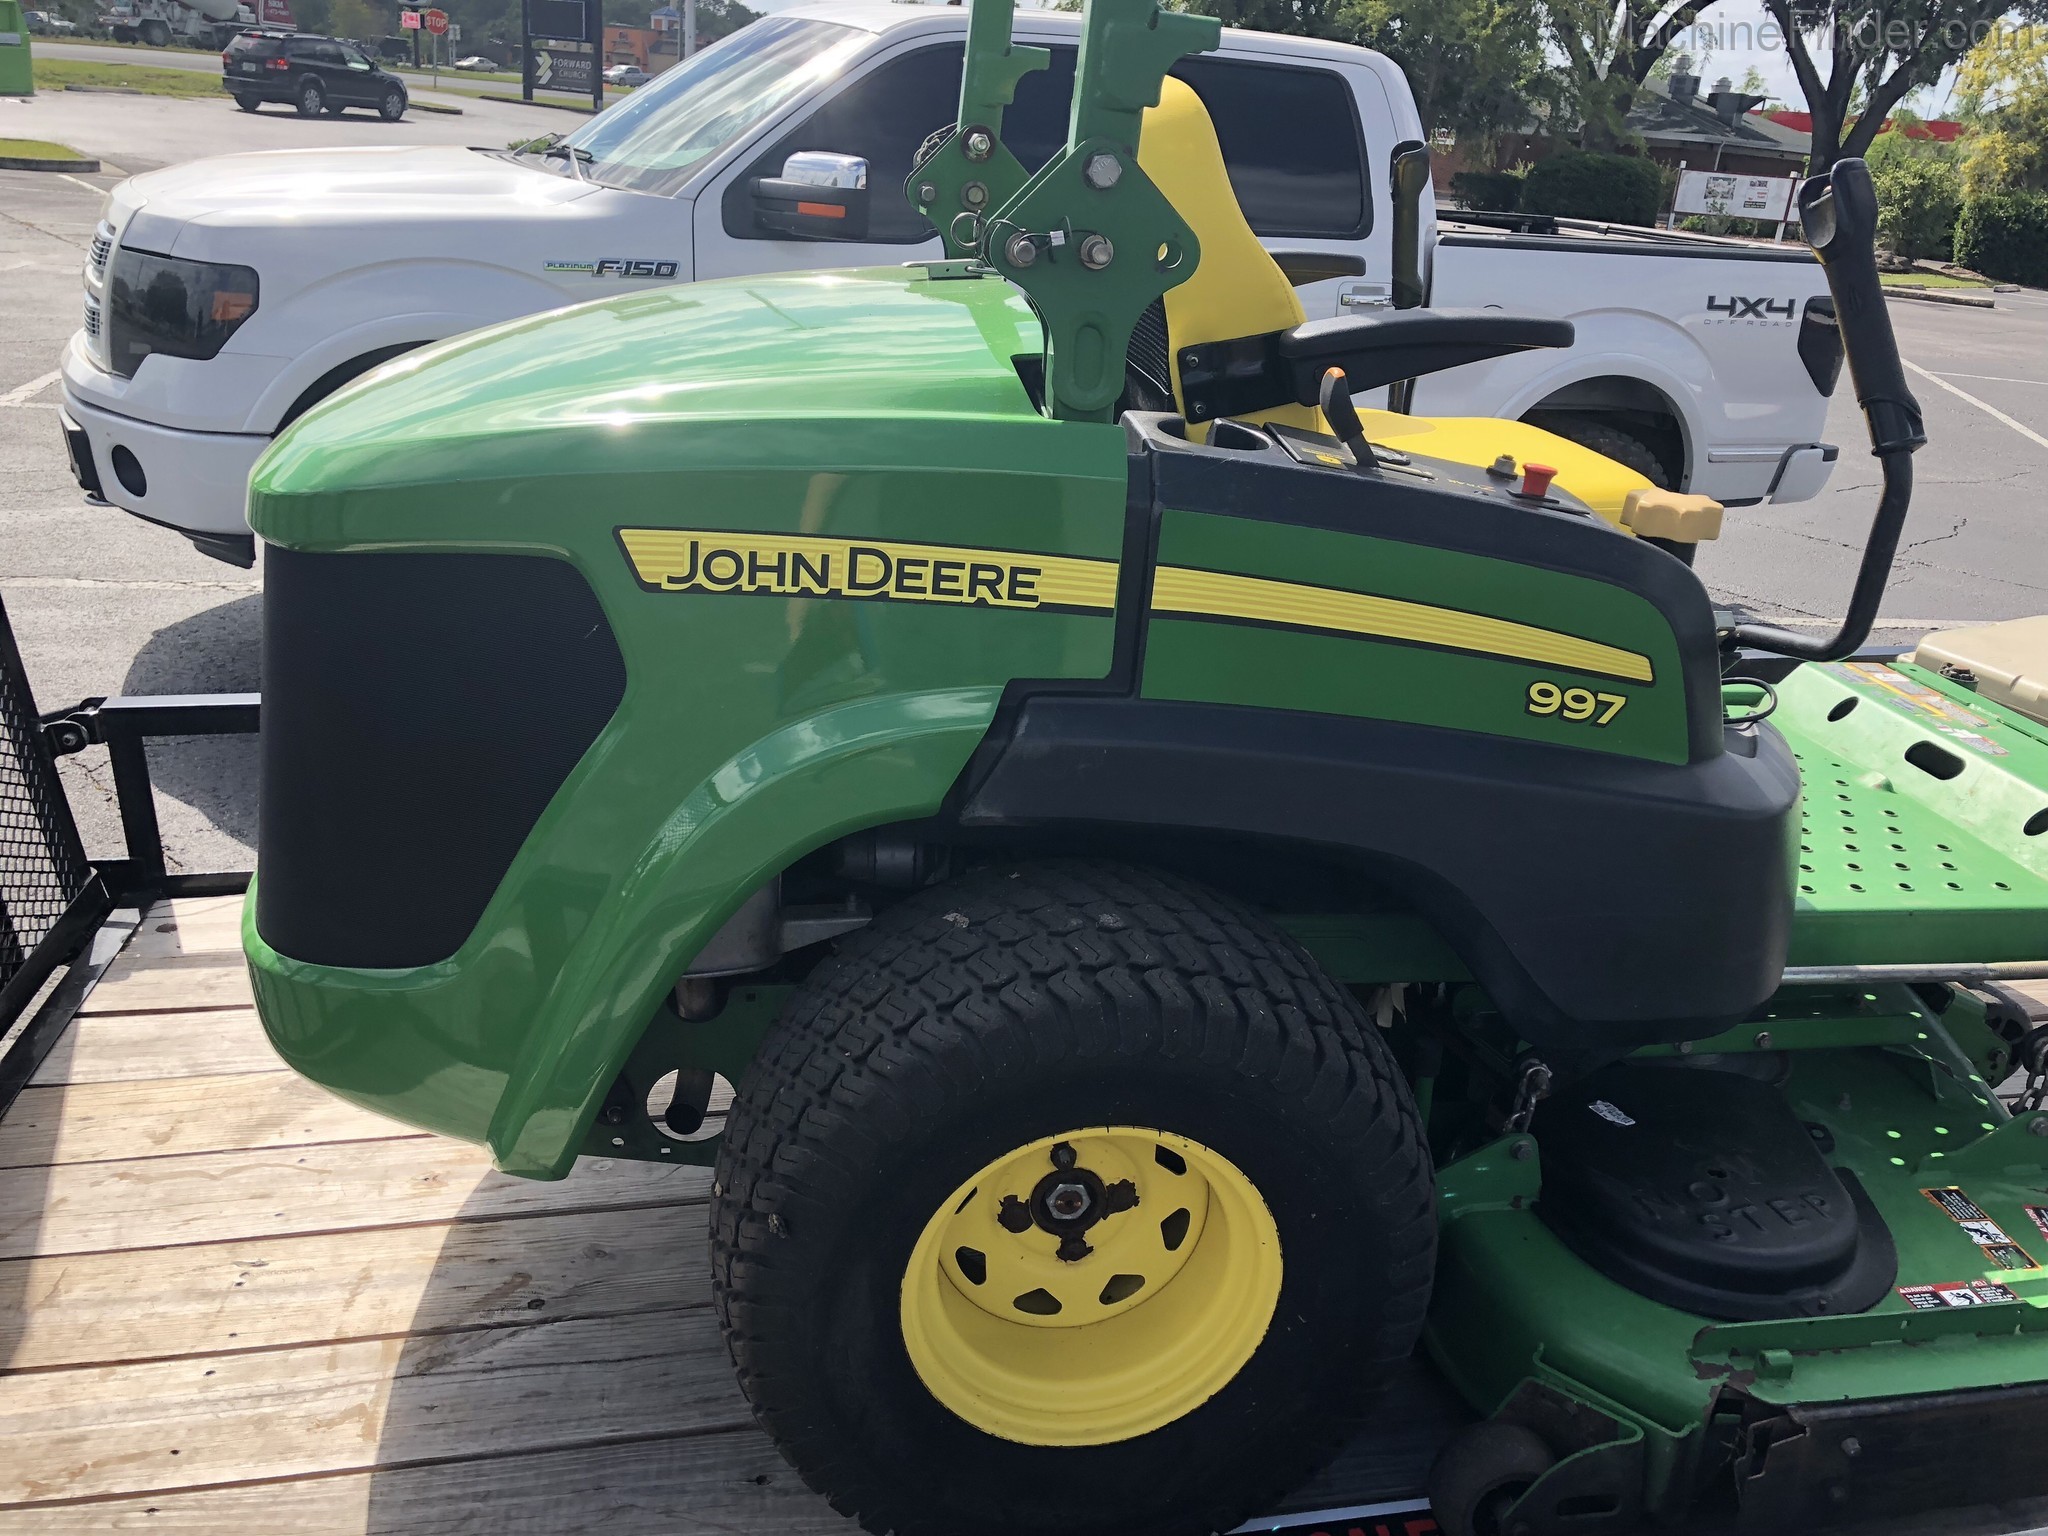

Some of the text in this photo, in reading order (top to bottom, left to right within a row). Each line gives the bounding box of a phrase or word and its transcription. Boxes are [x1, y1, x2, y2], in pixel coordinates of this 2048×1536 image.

[426, 16, 447, 27] STOP
[553, 57, 592, 70] FORWARD
[547, 260, 679, 277] PLATINUM F-150
[1527, 681, 1628, 726] 997
[1699, 1193, 1834, 1243] STEP
